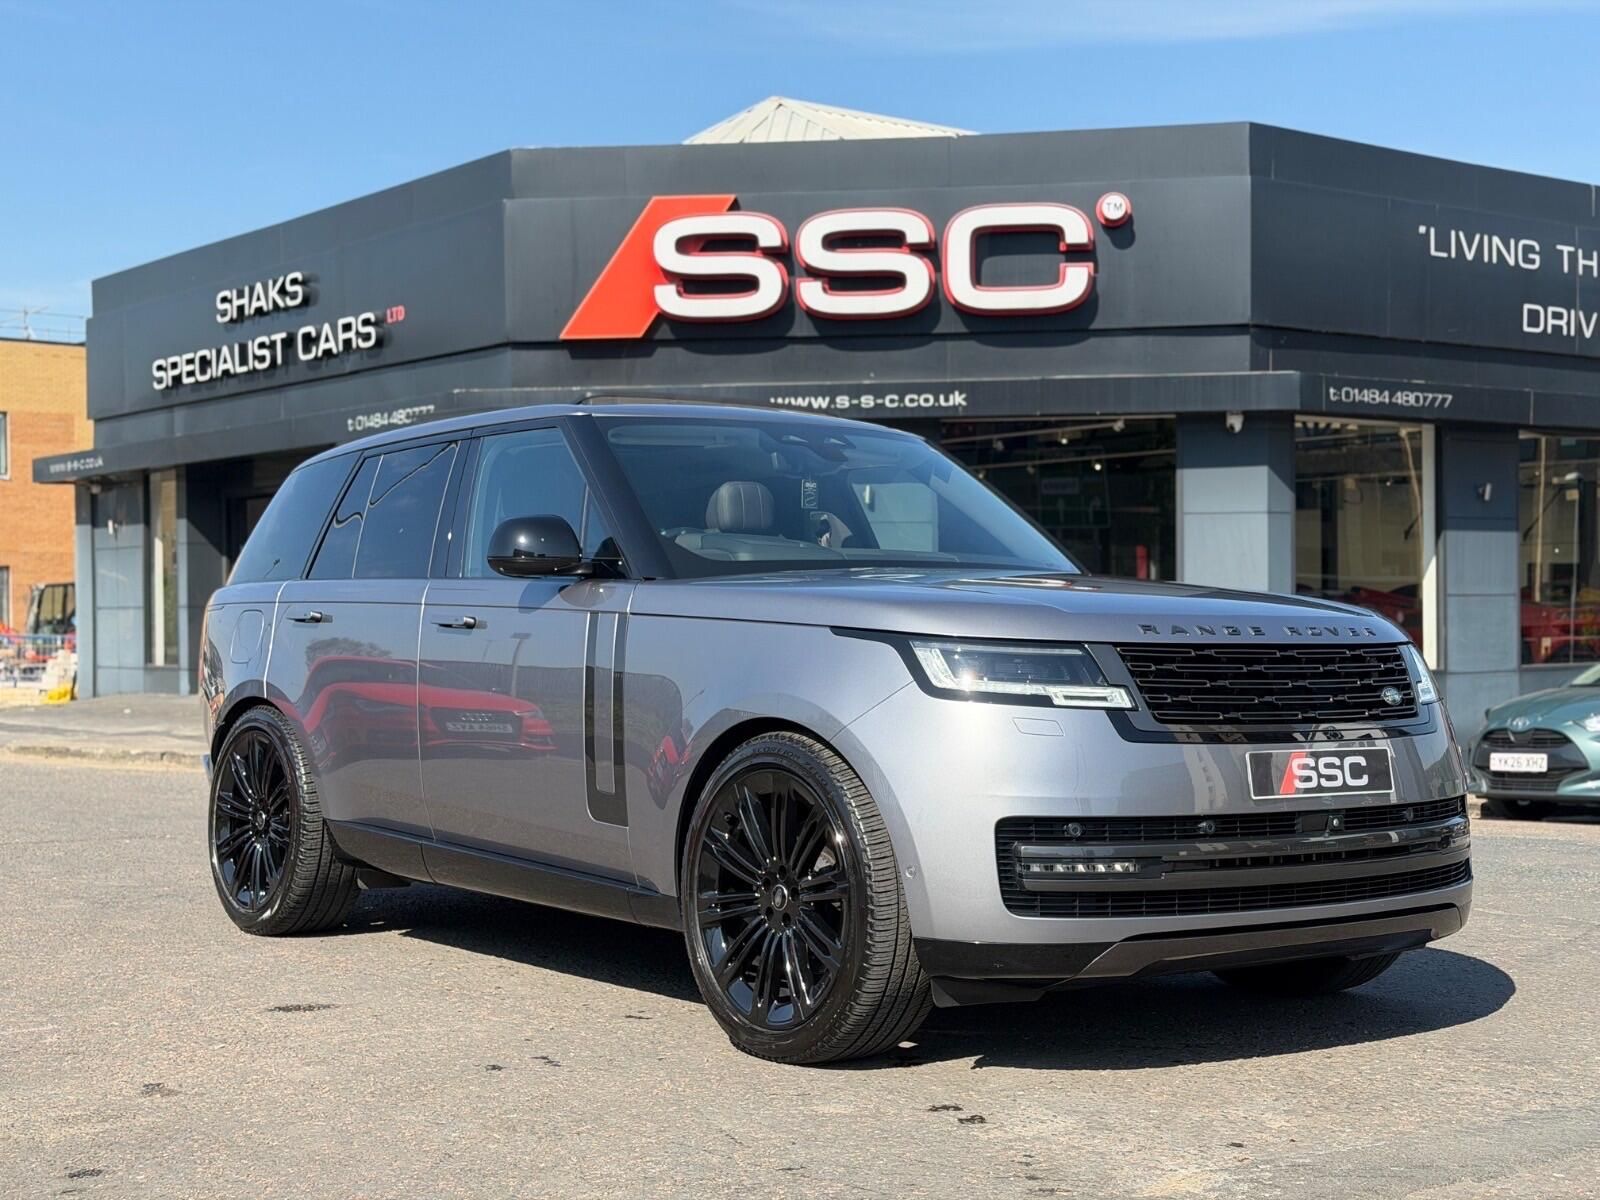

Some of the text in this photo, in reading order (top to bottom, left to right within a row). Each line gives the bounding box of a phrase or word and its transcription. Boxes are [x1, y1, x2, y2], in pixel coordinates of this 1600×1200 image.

[652, 202, 1094, 322] SSC
[215, 271, 304, 324] SHAKS
[151, 305, 406, 391] SPECIALIST CARS LTD
[1391, 391, 1453, 408] 480777
[1137, 623, 1378, 637] RANGE ROVER
[1291, 755, 1369, 789] SSC
